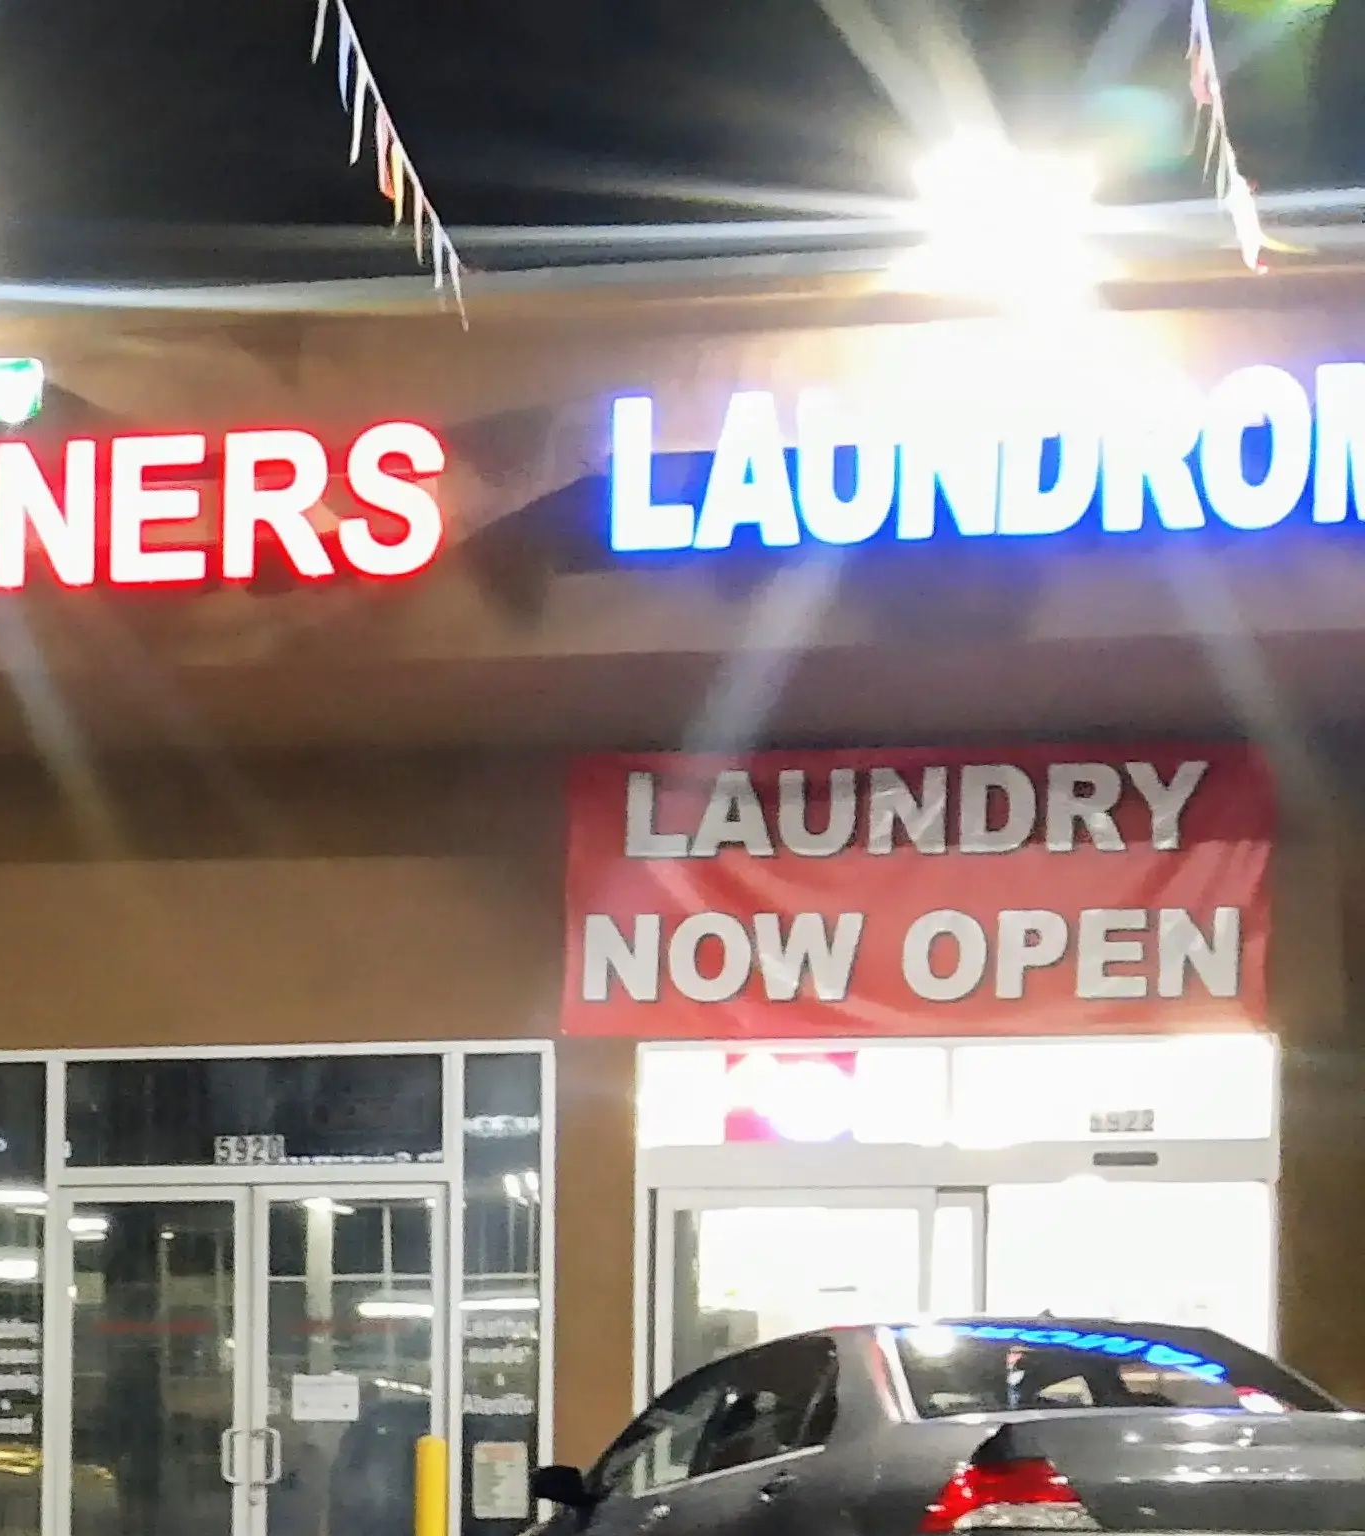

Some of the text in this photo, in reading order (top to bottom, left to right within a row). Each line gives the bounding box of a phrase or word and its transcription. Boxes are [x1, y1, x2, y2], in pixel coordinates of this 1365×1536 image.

[623, 760, 1209, 860] LAUNDRY
[582, 907, 1241, 1004] NOW OPEN
